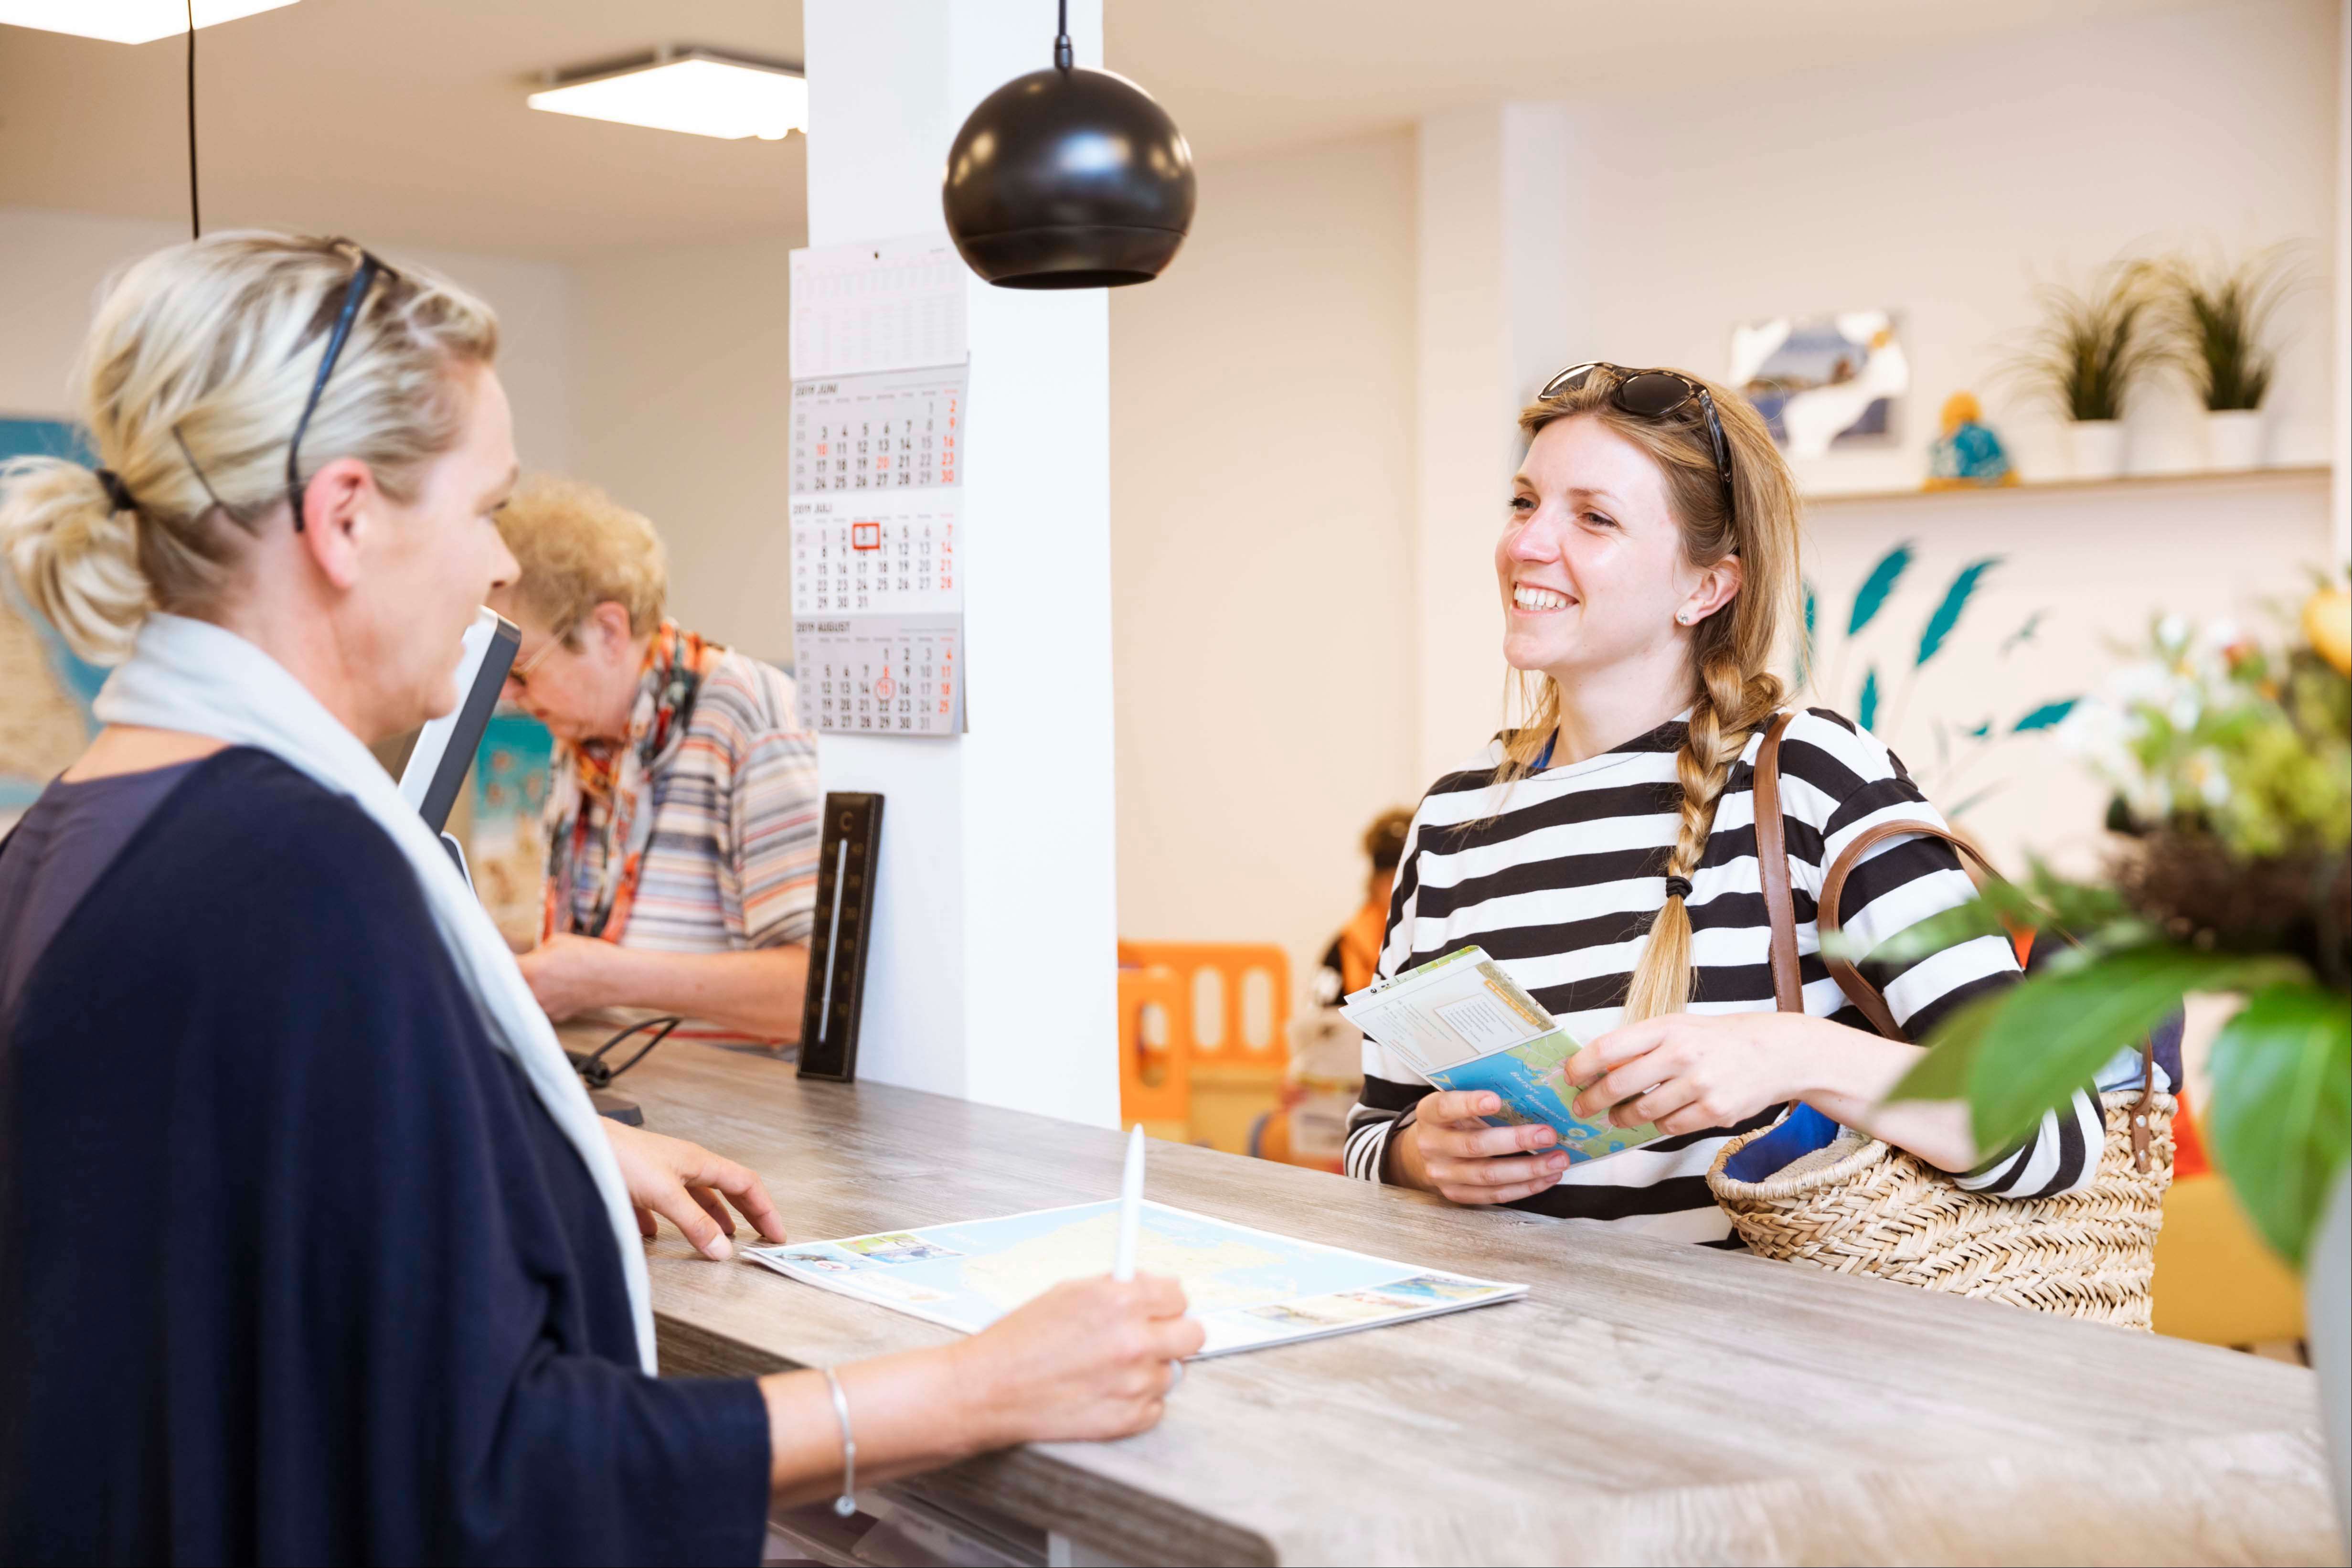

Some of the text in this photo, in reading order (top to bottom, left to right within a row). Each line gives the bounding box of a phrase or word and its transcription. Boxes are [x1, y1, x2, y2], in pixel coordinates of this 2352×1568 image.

[793, 503, 832, 515] 2019 JULI
[796, 621, 851, 633] 2019 AUGUST
[840, 811, 853, 832] C
[1510, 1071, 1541, 1095] Burger
[1525, 1094, 1569, 1122] Binnensee
